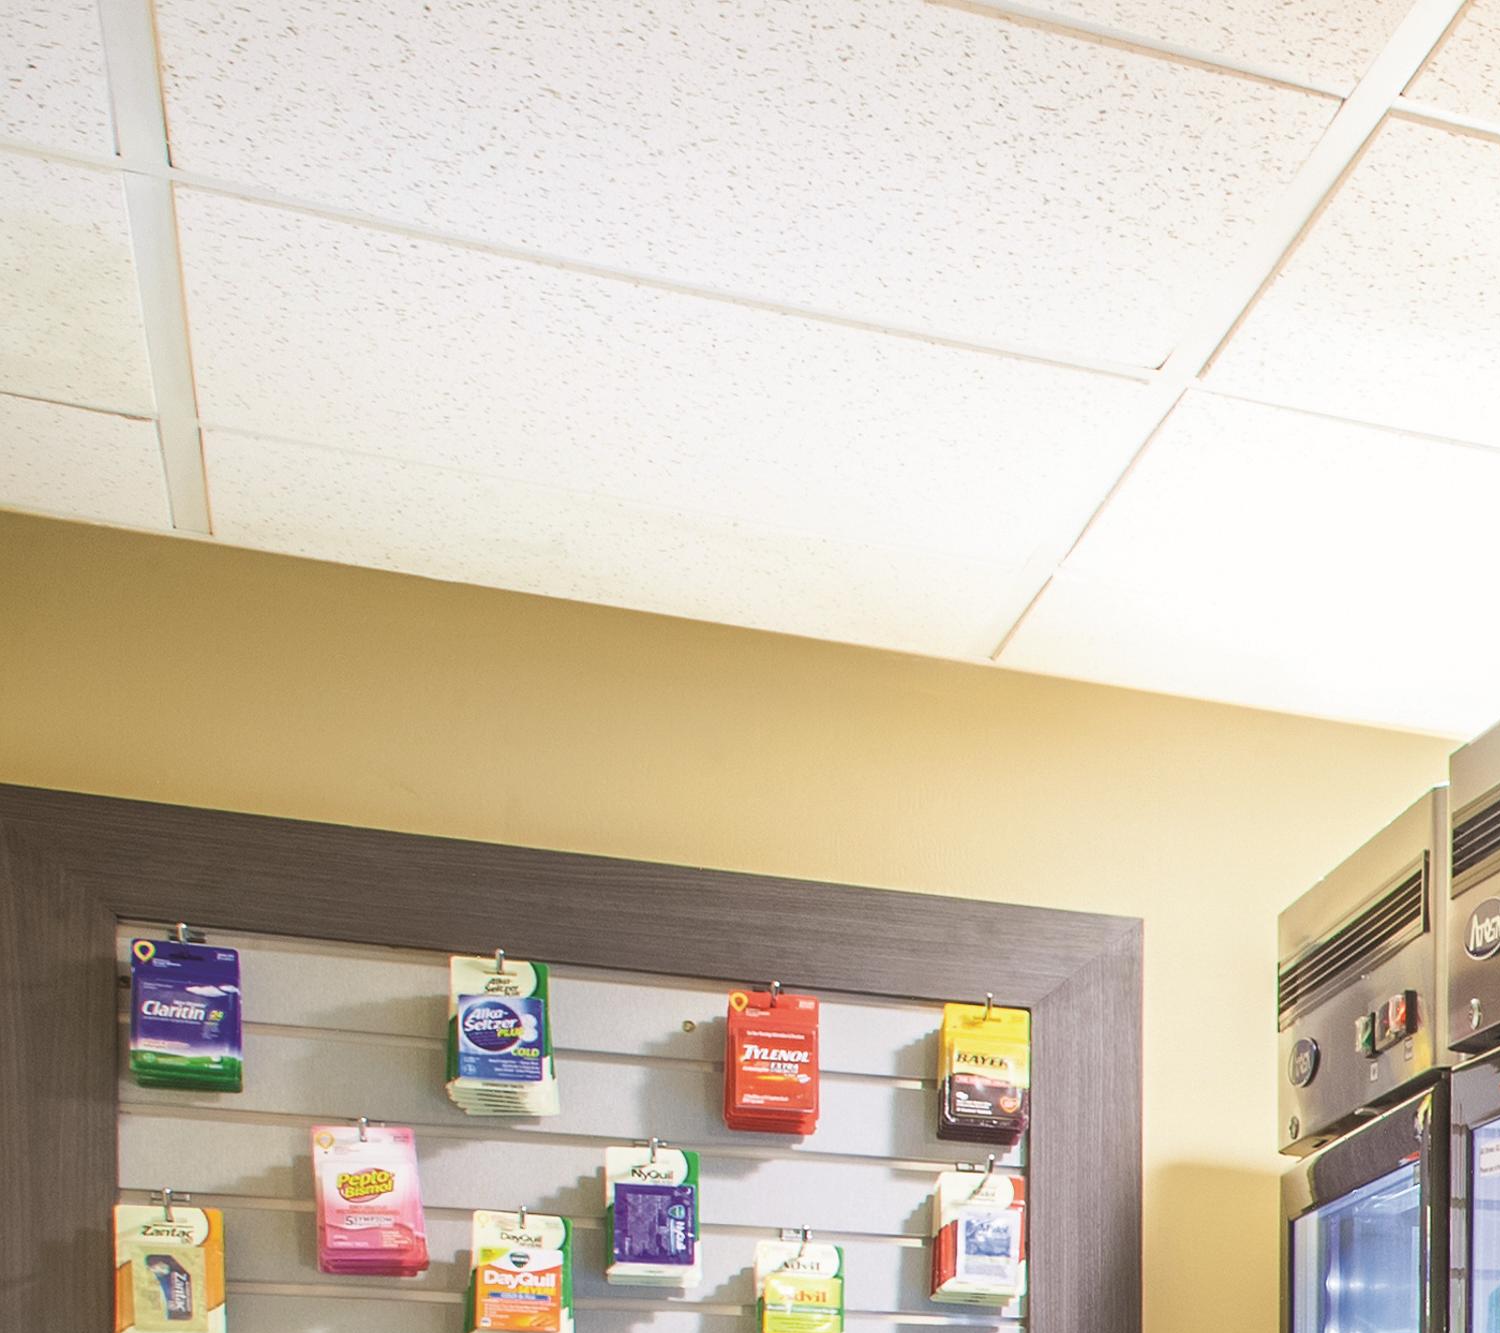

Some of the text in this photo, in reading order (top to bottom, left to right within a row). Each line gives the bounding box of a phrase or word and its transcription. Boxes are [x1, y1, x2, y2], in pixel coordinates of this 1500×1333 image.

[142, 1001, 205, 1020] Claritin
[464, 1019, 517, 1032] Seltzer
[512, 1048, 540, 1057] COLD
[742, 1044, 810, 1063] TYLENOL
[631, 1168, 674, 1181] NyQuil
[345, 1181, 392, 1198] Bismol
[501, 1233, 542, 1244] DayQuil
[484, 1270, 556, 1288] DayQuil
